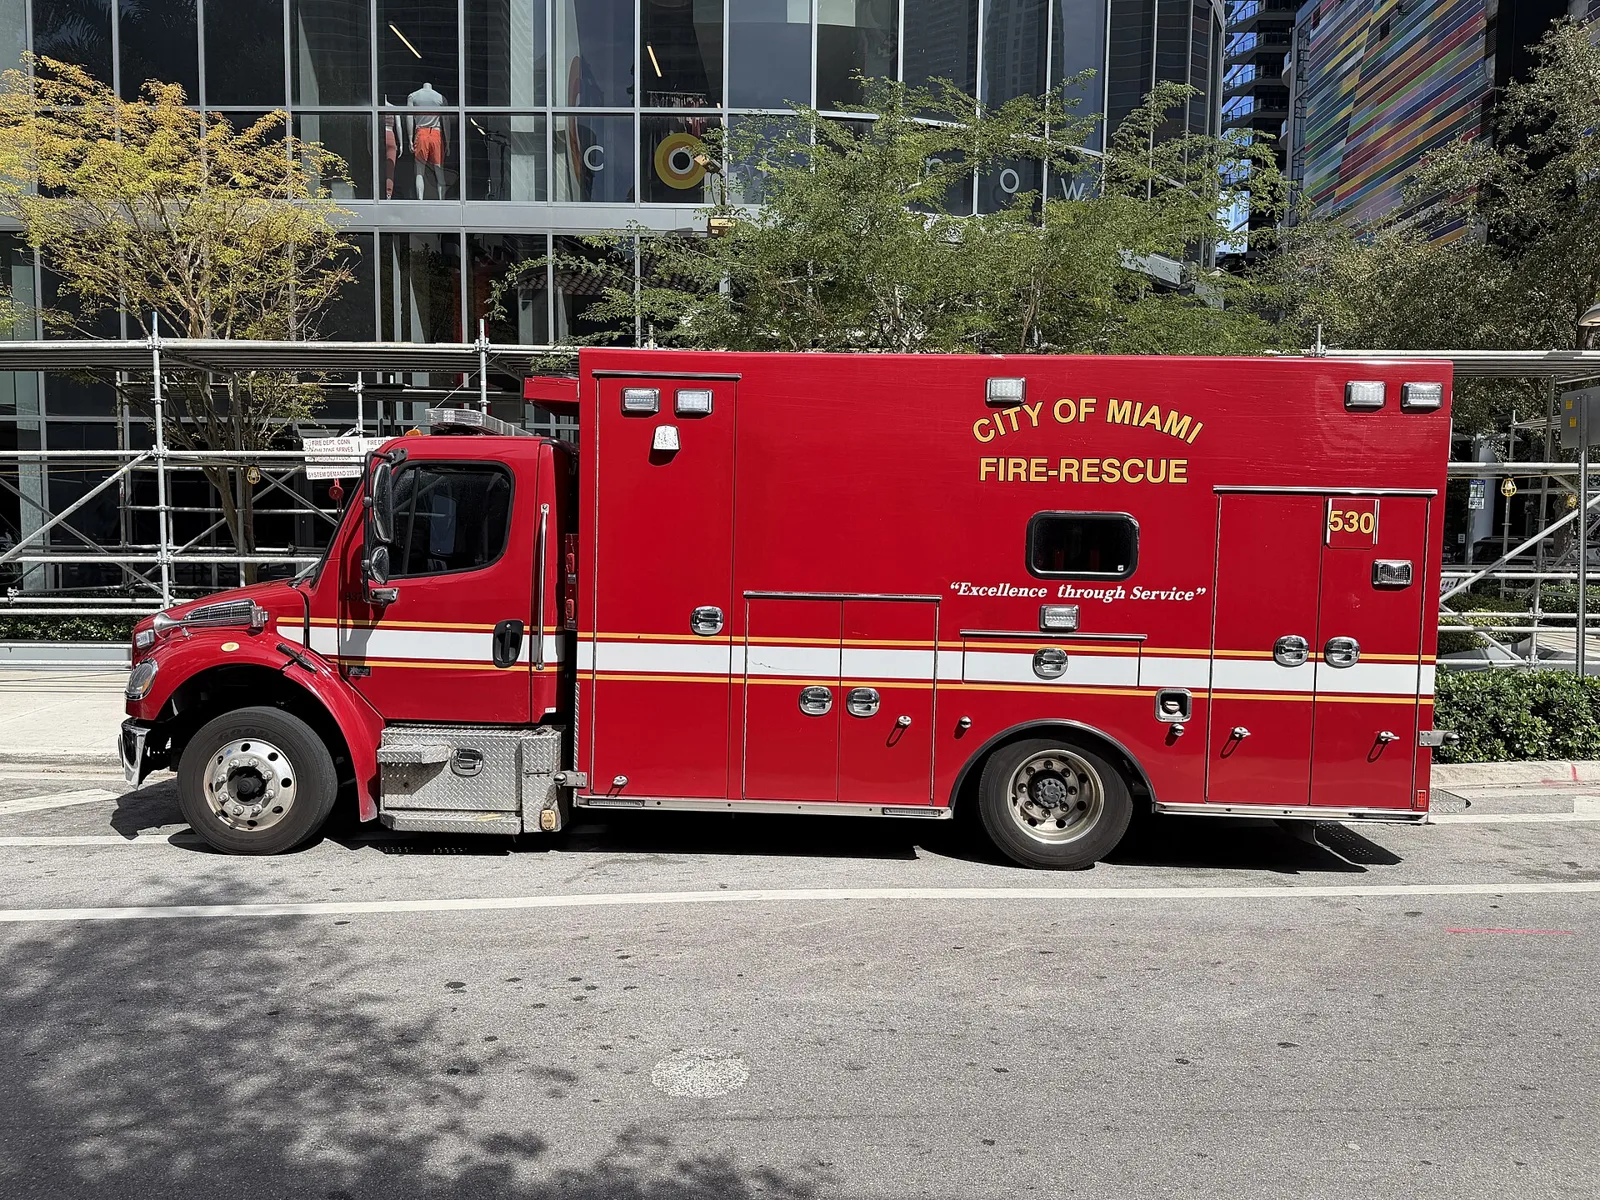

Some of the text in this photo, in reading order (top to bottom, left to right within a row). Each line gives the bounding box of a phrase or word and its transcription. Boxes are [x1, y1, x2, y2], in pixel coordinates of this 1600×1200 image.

[972, 398, 1204, 445] CITY OF MIAMI
[979, 457, 1188, 484] FIRE-RESCUE
[1329, 510, 1375, 534] 530
[950, 582, 1206, 603] “Excellence through Service”
